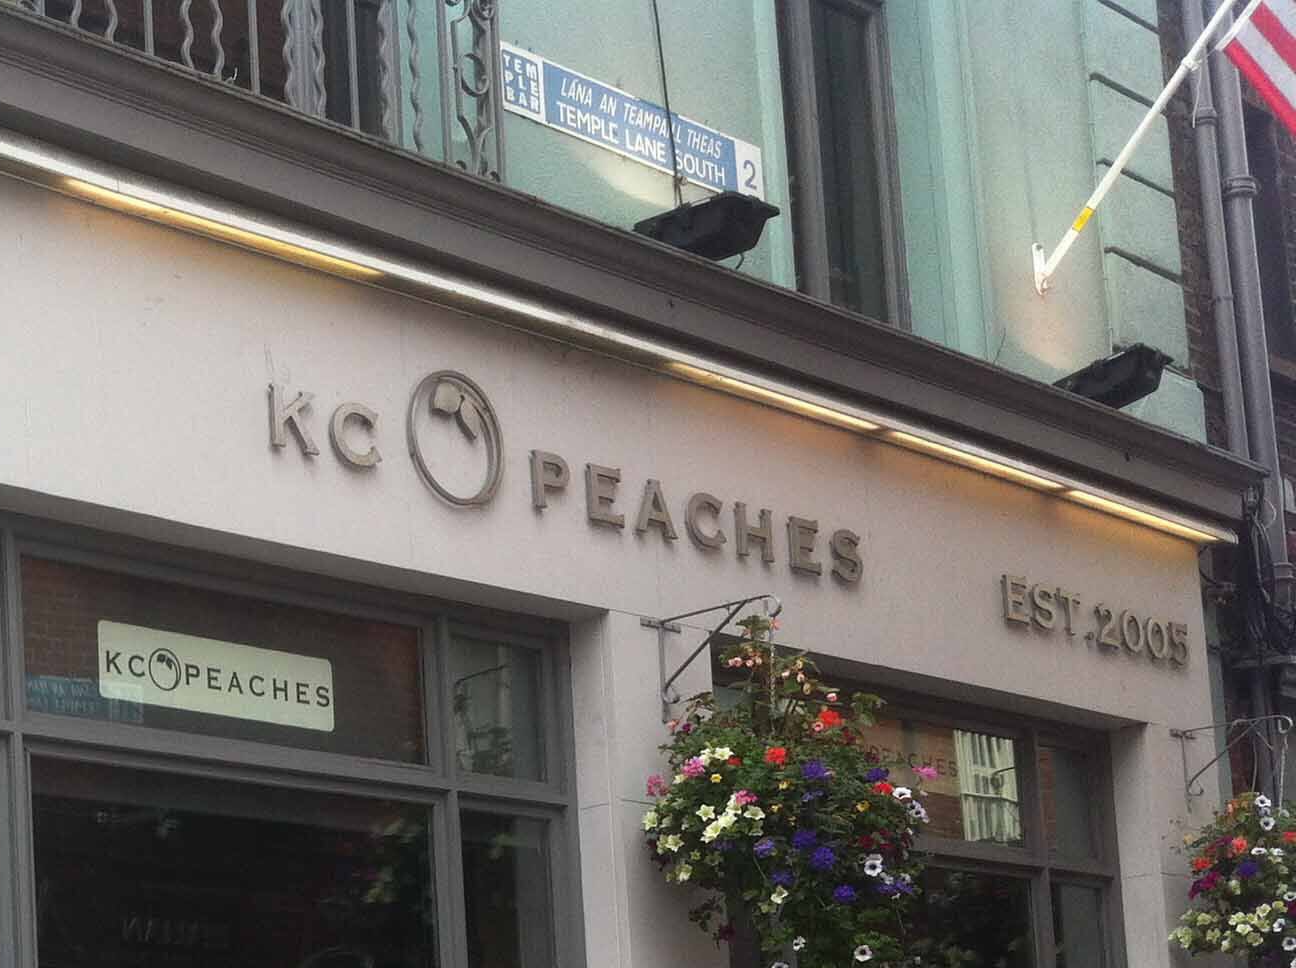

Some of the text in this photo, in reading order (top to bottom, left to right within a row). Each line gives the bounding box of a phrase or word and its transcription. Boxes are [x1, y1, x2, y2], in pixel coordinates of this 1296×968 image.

[556, 101, 726, 186] TEMPLE LANE SOUTH
[600, 93, 616, 117] AN
[687, 128, 723, 160] THEAS
[743, 159, 758, 190] 2
[267, 383, 864, 583] KC PEACHES
[105, 650, 146, 678] KC
[184, 664, 331, 708] PEACHES
